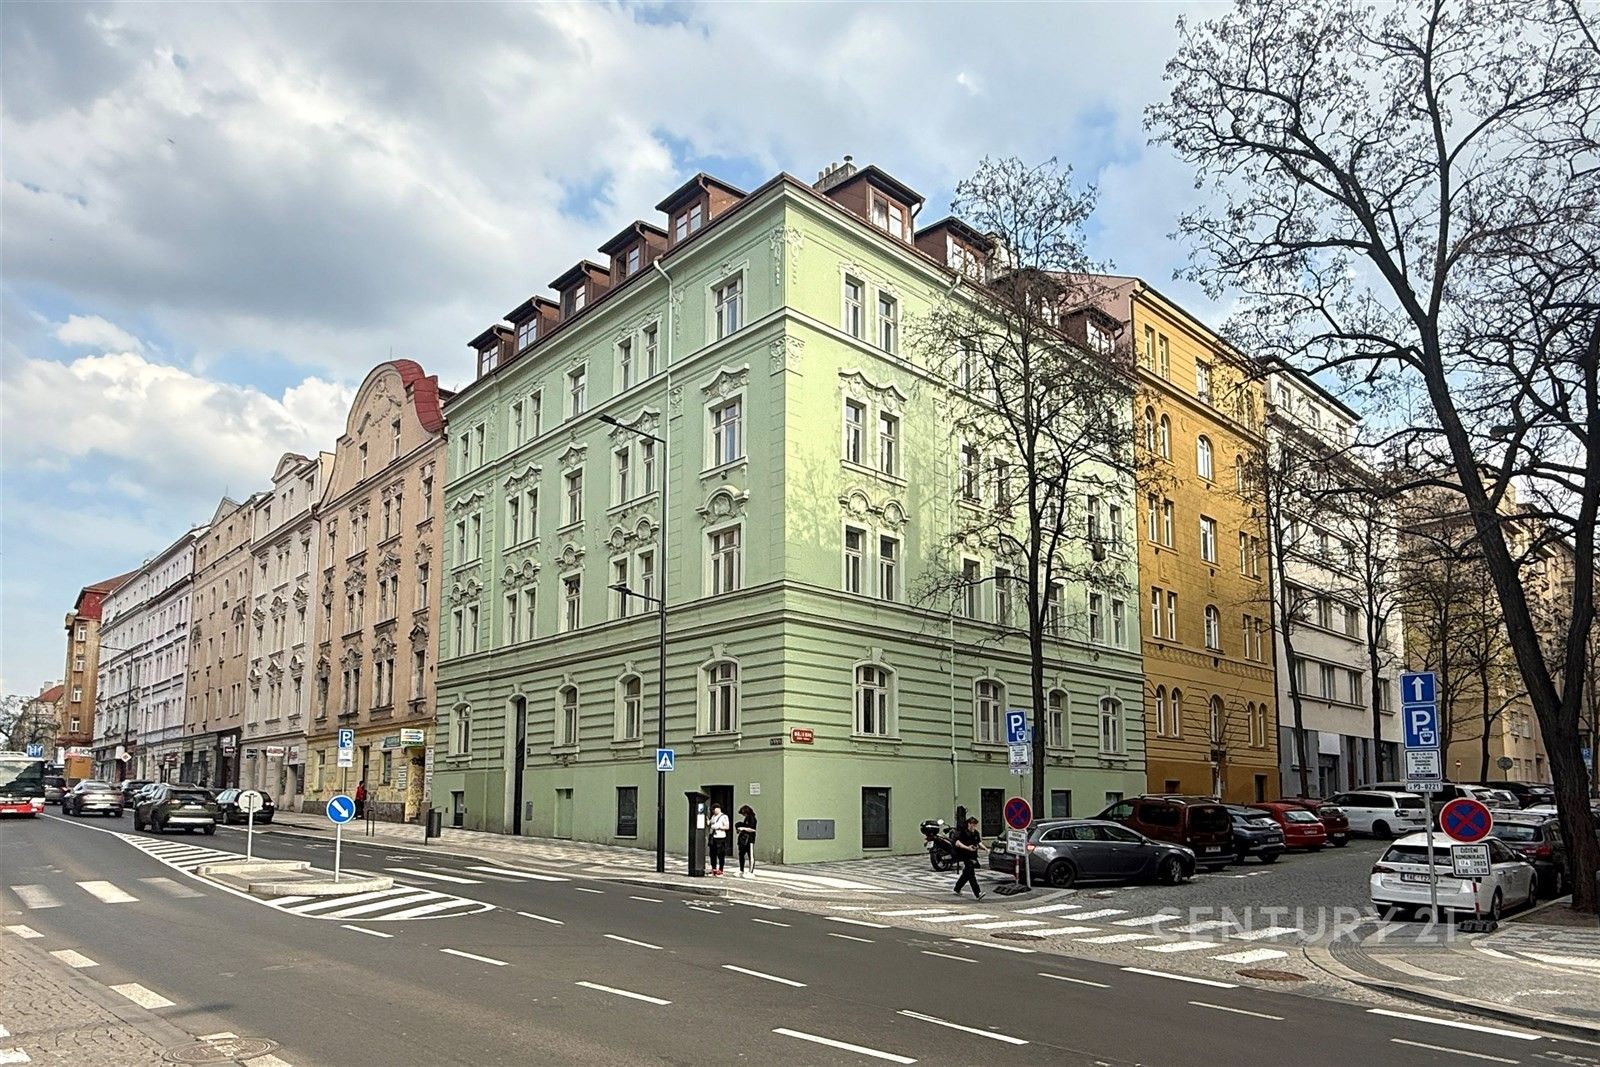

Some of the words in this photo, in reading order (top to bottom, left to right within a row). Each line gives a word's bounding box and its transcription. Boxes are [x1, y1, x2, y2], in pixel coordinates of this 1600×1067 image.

[1010, 714, 1023, 733] P
[1411, 710, 1431, 735] P
[342, 731, 352, 743] P
